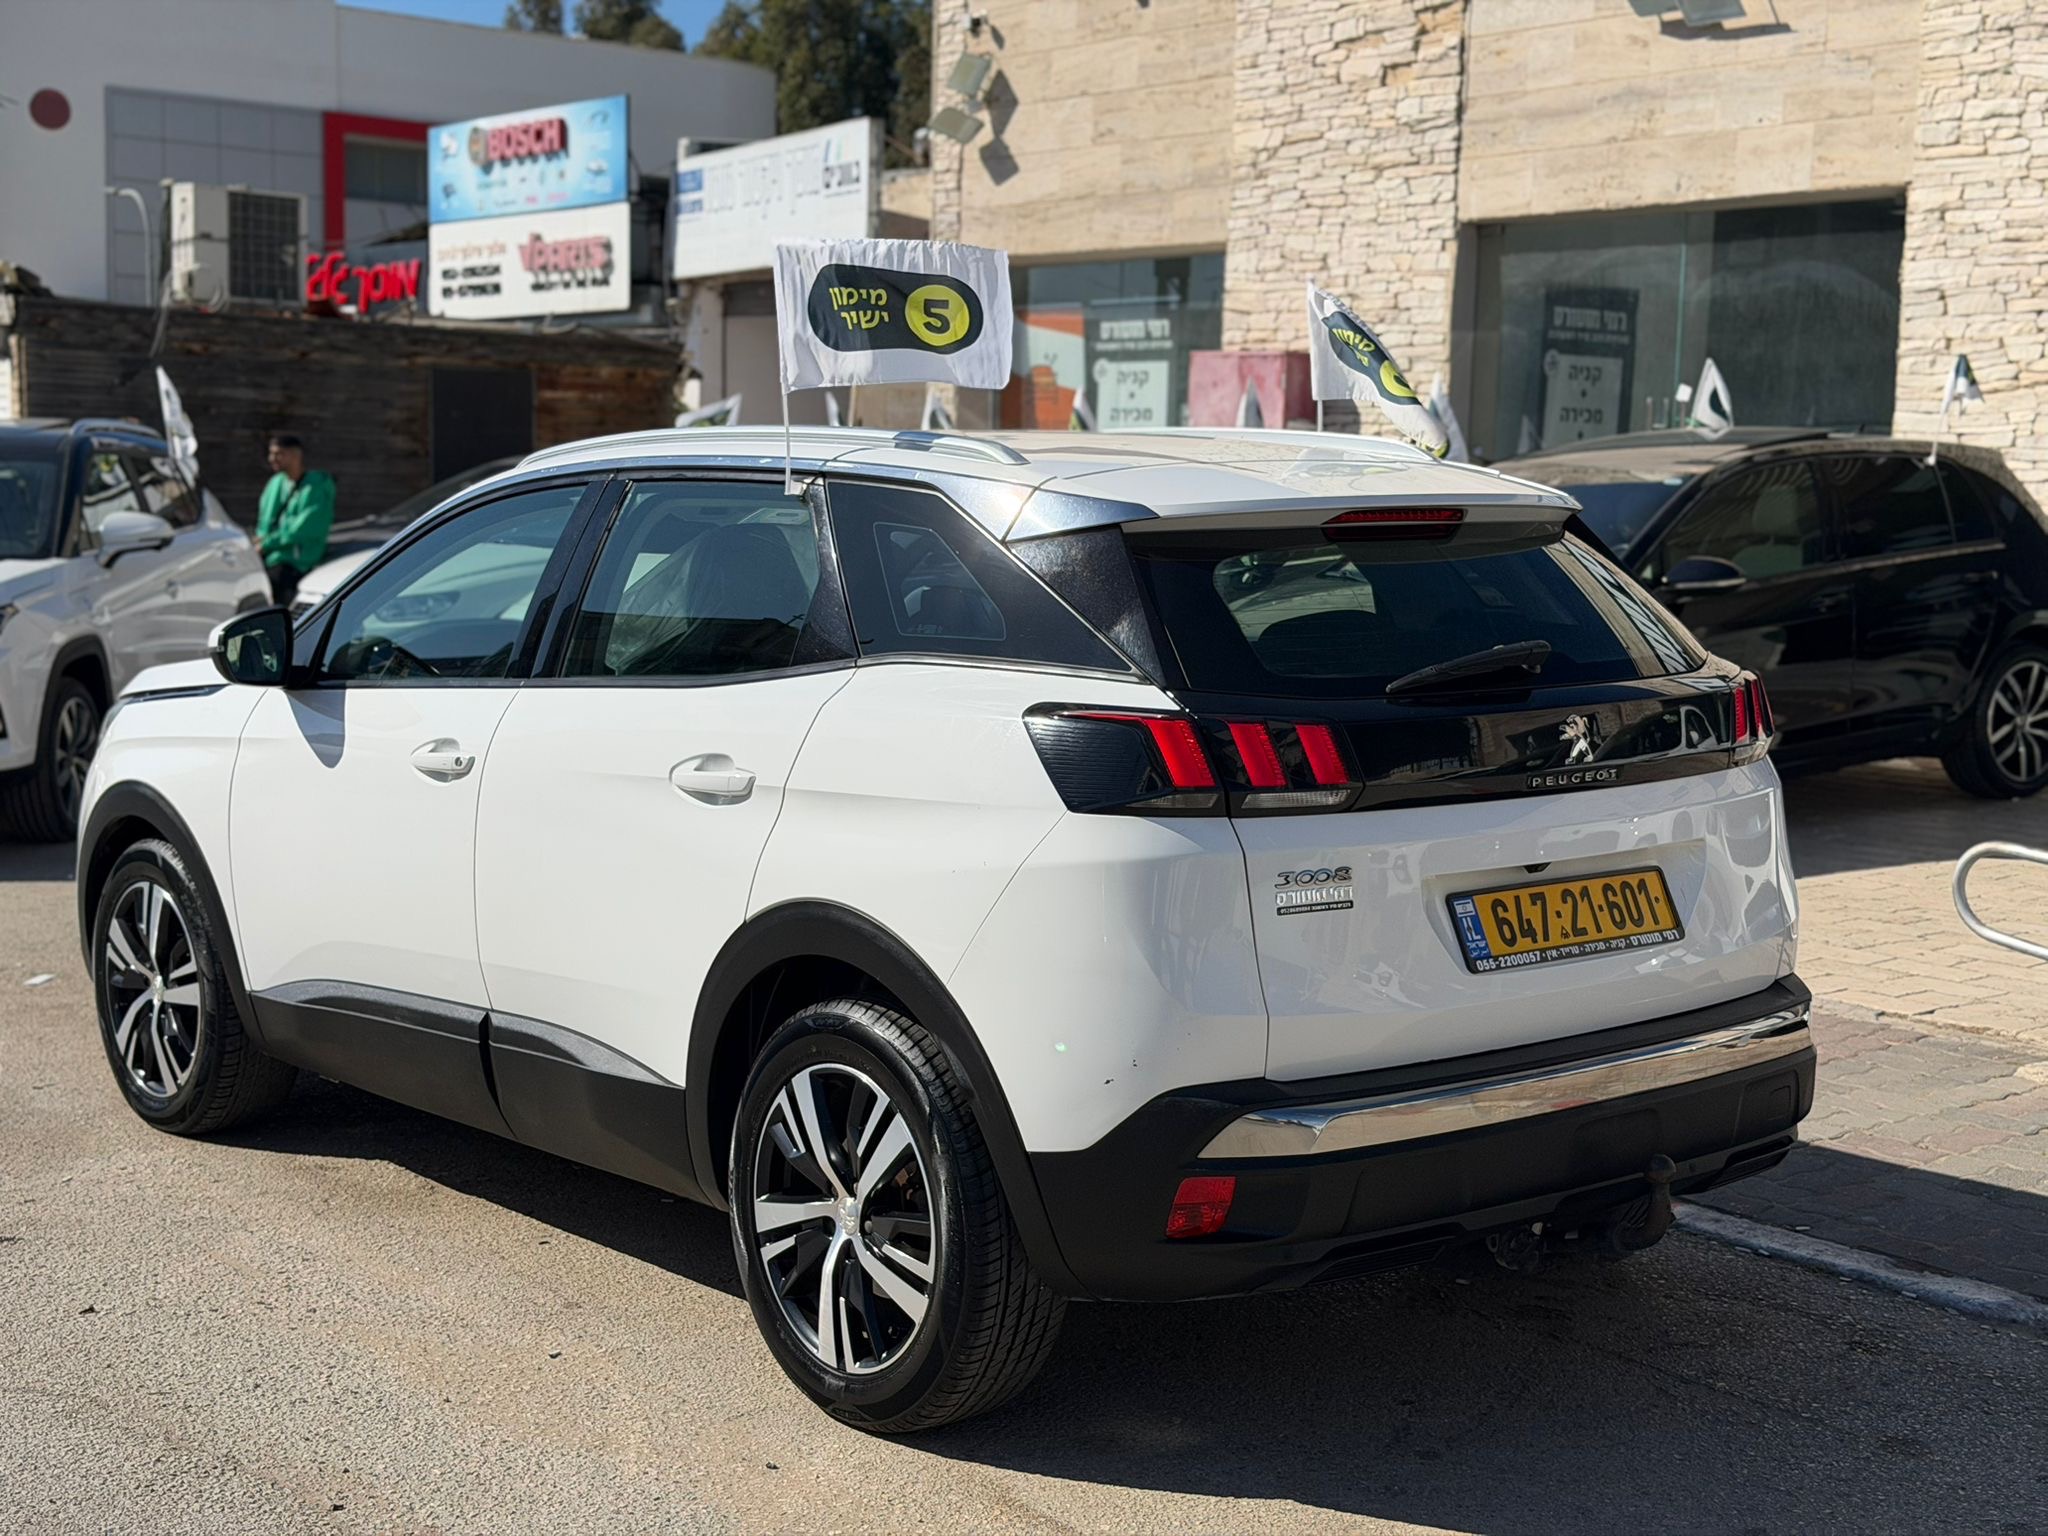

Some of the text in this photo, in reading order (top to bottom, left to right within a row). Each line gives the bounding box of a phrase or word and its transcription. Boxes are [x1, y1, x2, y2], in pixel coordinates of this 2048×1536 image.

[487, 118, 566, 161] BOSCH
[829, 286, 888, 311] מימון
[840, 310, 890, 331] ישיר
[922, 298, 951, 334] 5
[1568, 363, 1603, 387] קניה
[1559, 405, 1604, 425] מכירה
[1531, 768, 1618, 788] PEUGEOT
[1274, 866, 1353, 890] 3008
[1461, 916, 1481, 941] IL
[1630, 931, 1663, 946] מוטורס
[1664, 929, 1680, 941] רמי
[1584, 941, 1606, 953] מכירה
[1609, 938, 1627, 949] קניה
[1475, 950, 1542, 971] 055-2200057
